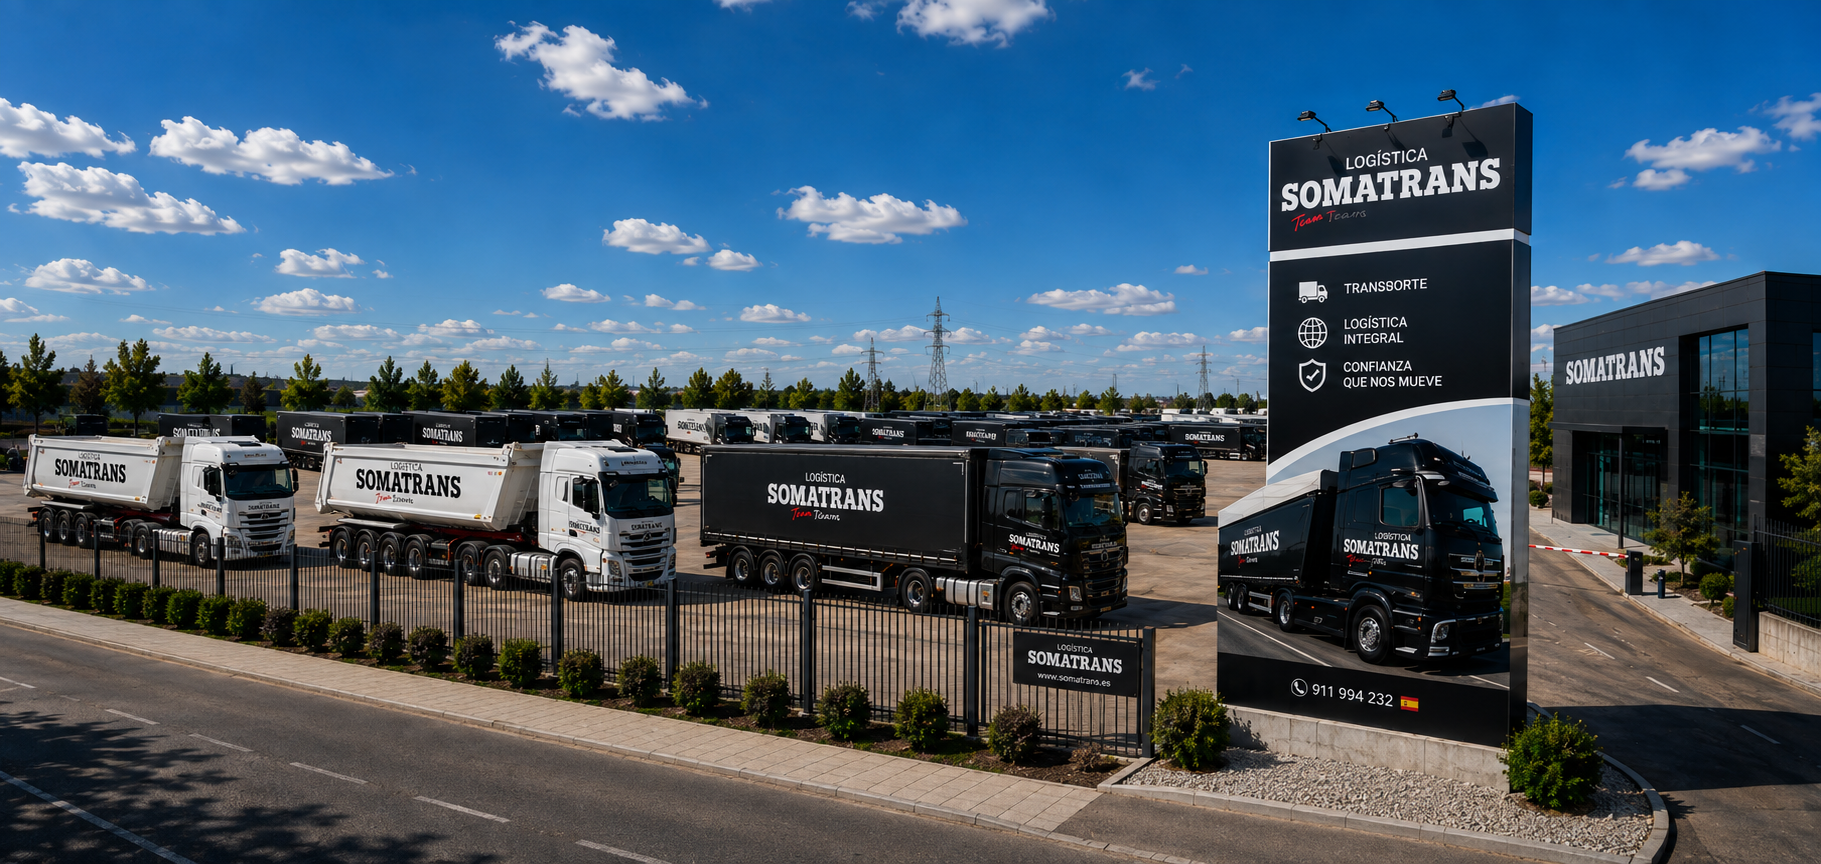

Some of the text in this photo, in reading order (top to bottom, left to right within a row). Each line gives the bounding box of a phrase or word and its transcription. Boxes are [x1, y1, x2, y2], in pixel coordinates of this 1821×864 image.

[1345, 147, 1429, 171] LOGÍSTICA
[1281, 157, 1501, 212] SOMATRANS
[1344, 315, 1408, 330] LOGÍSTICA
[1344, 332, 1404, 345] INTEGRAL
[1343, 360, 1413, 373] CONFIANZA
[1565, 346, 1665, 385] SOMATRANS
[1343, 375, 1443, 389] QUE NOS MUEVE
[55, 458, 126, 483] SOMATRANS
[805, 471, 846, 484] LOGÍSTICA
[356, 468, 461, 499] SOMATRANS
[767, 483, 884, 513] SOMATRANS
[1009, 534, 1060, 553] SOMATRANS
[1231, 530, 1280, 556] SOMATRANS
[1343, 538, 1419, 560] SOMATRANS
[1056, 643, 1094, 654] LOGÍSTICA
[1027, 650, 1123, 674] SOMATRANS
[1037, 672, 1111, 688] www.somatrans.es
[1312, 683, 1394, 707] 911 994 232
